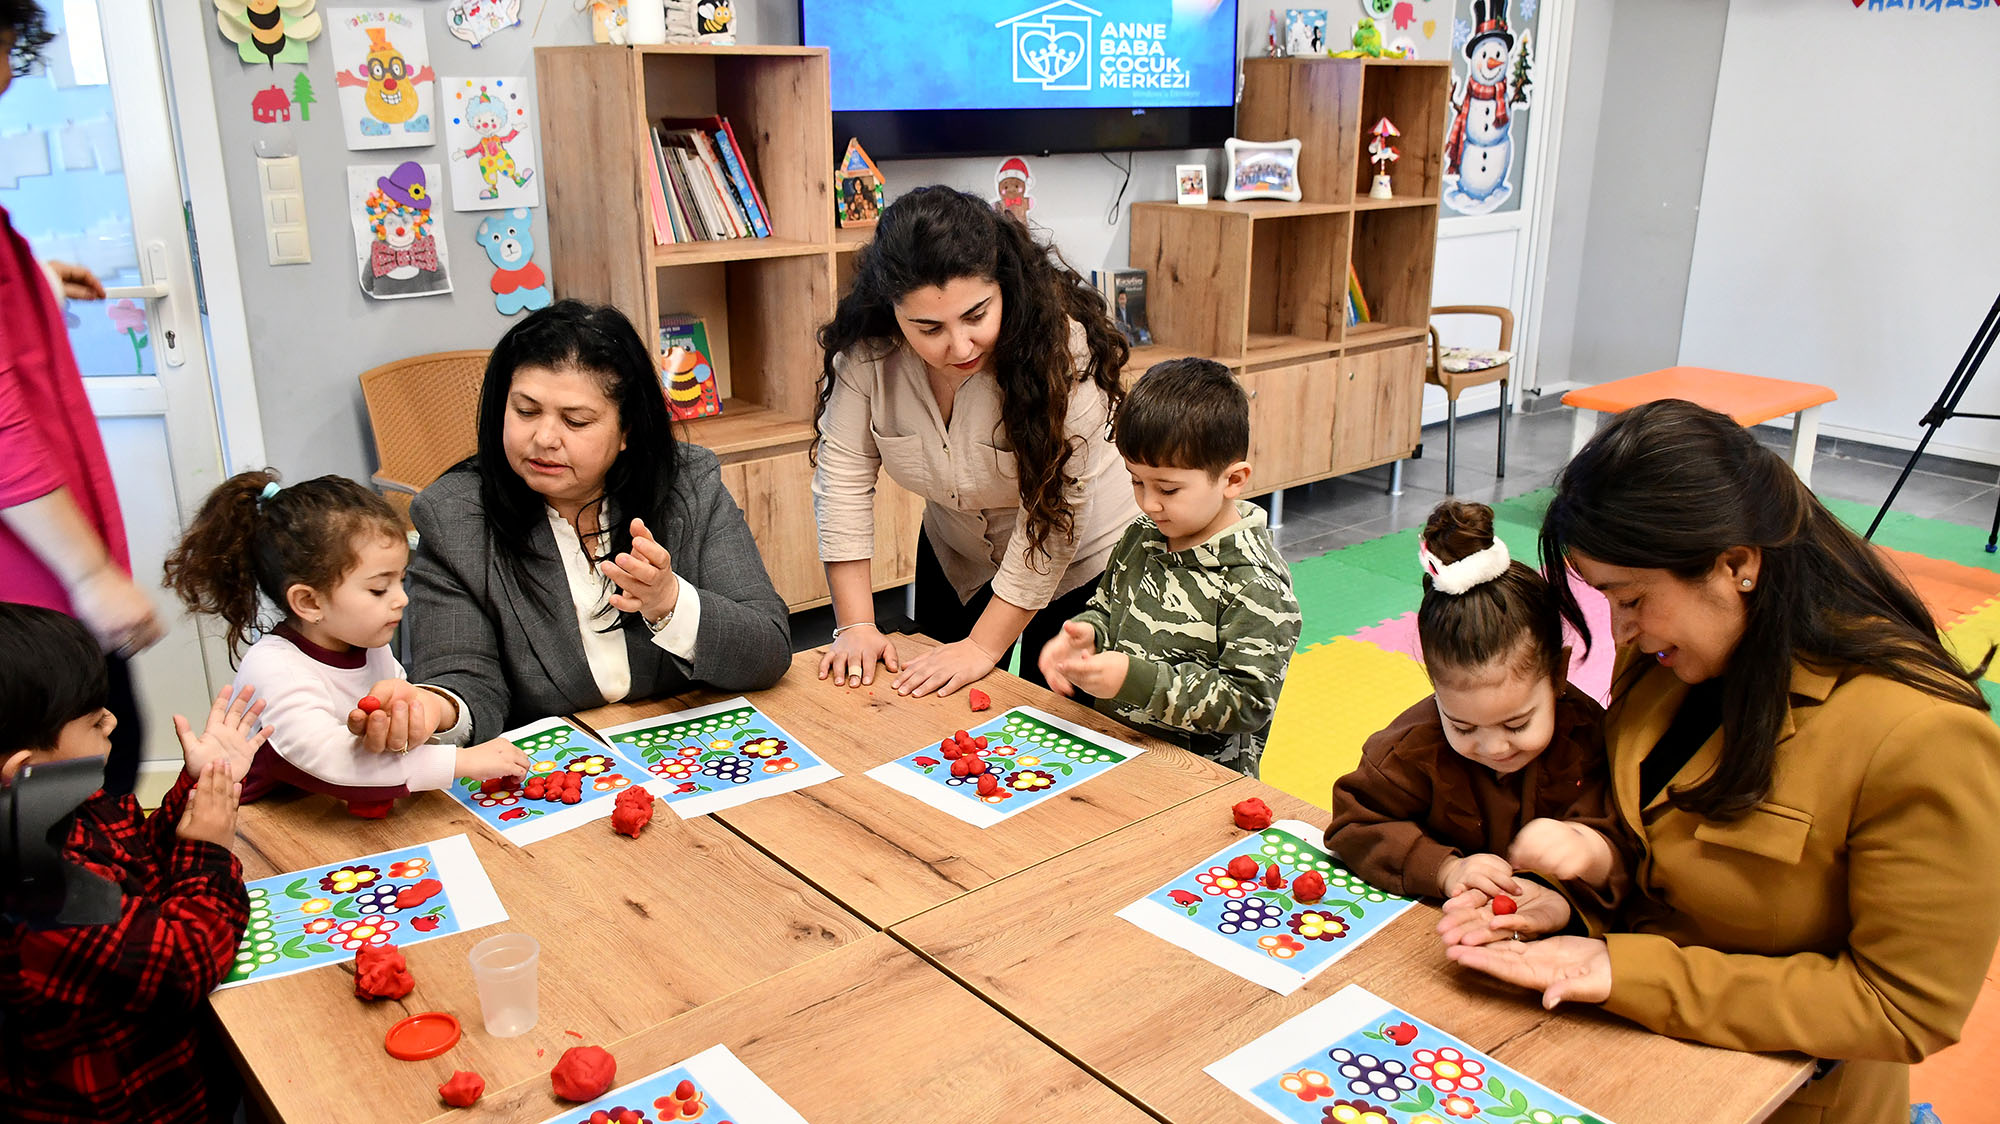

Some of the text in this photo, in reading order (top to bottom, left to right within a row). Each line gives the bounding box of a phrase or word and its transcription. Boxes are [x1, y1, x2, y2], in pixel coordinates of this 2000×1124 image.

[1101, 22, 1167, 39] ANNE
[1100, 39, 1165, 56] BABA
[1100, 56, 1181, 76] ÇOCUK
[1100, 70, 1190, 88] MERKEZİ
